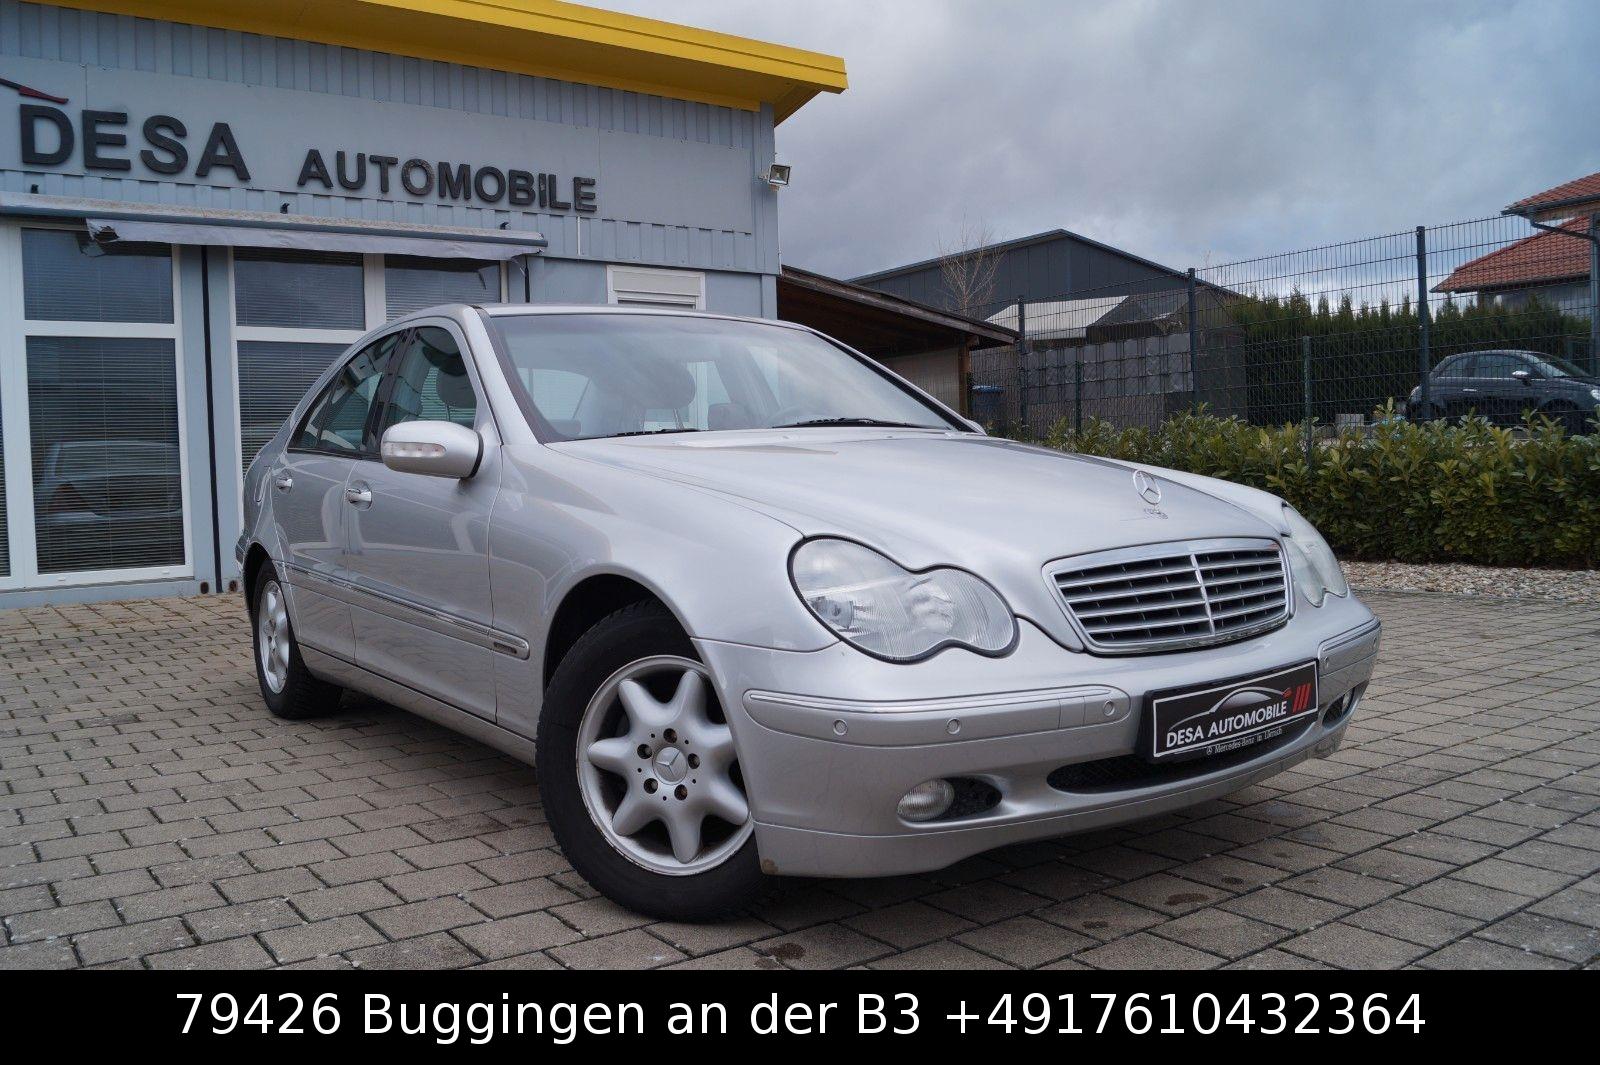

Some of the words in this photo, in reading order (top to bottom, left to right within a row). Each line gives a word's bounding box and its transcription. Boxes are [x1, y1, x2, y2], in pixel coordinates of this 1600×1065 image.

[20, 103, 250, 181] DESA
[297, 149, 598, 212] AUTOMOBILE
[1166, 725, 1204, 748] DESA
[1207, 700, 1288, 738] AUTOMOBILE
